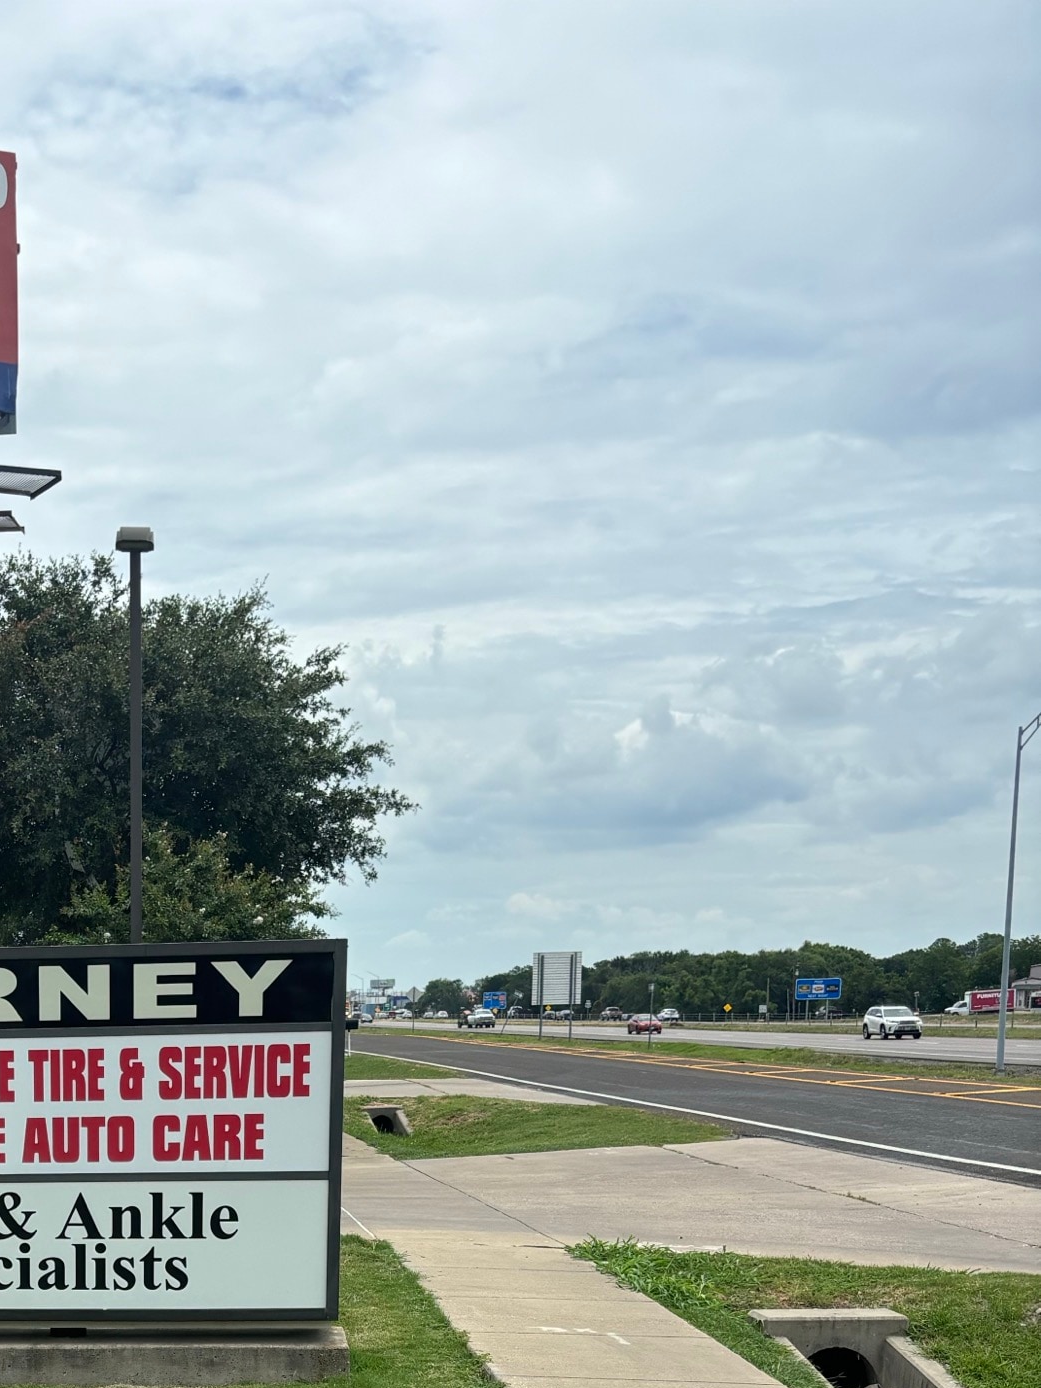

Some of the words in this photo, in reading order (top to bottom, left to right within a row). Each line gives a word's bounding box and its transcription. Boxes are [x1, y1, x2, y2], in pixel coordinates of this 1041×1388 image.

[28, 1047, 105, 1104] TIRE
[118, 1045, 146, 1101] &
[158, 1042, 312, 1101] SERVICE
[21, 1115, 136, 1164] AUTO
[152, 1113, 265, 1162] CARE
[55, 1190, 240, 1241] Ankle
